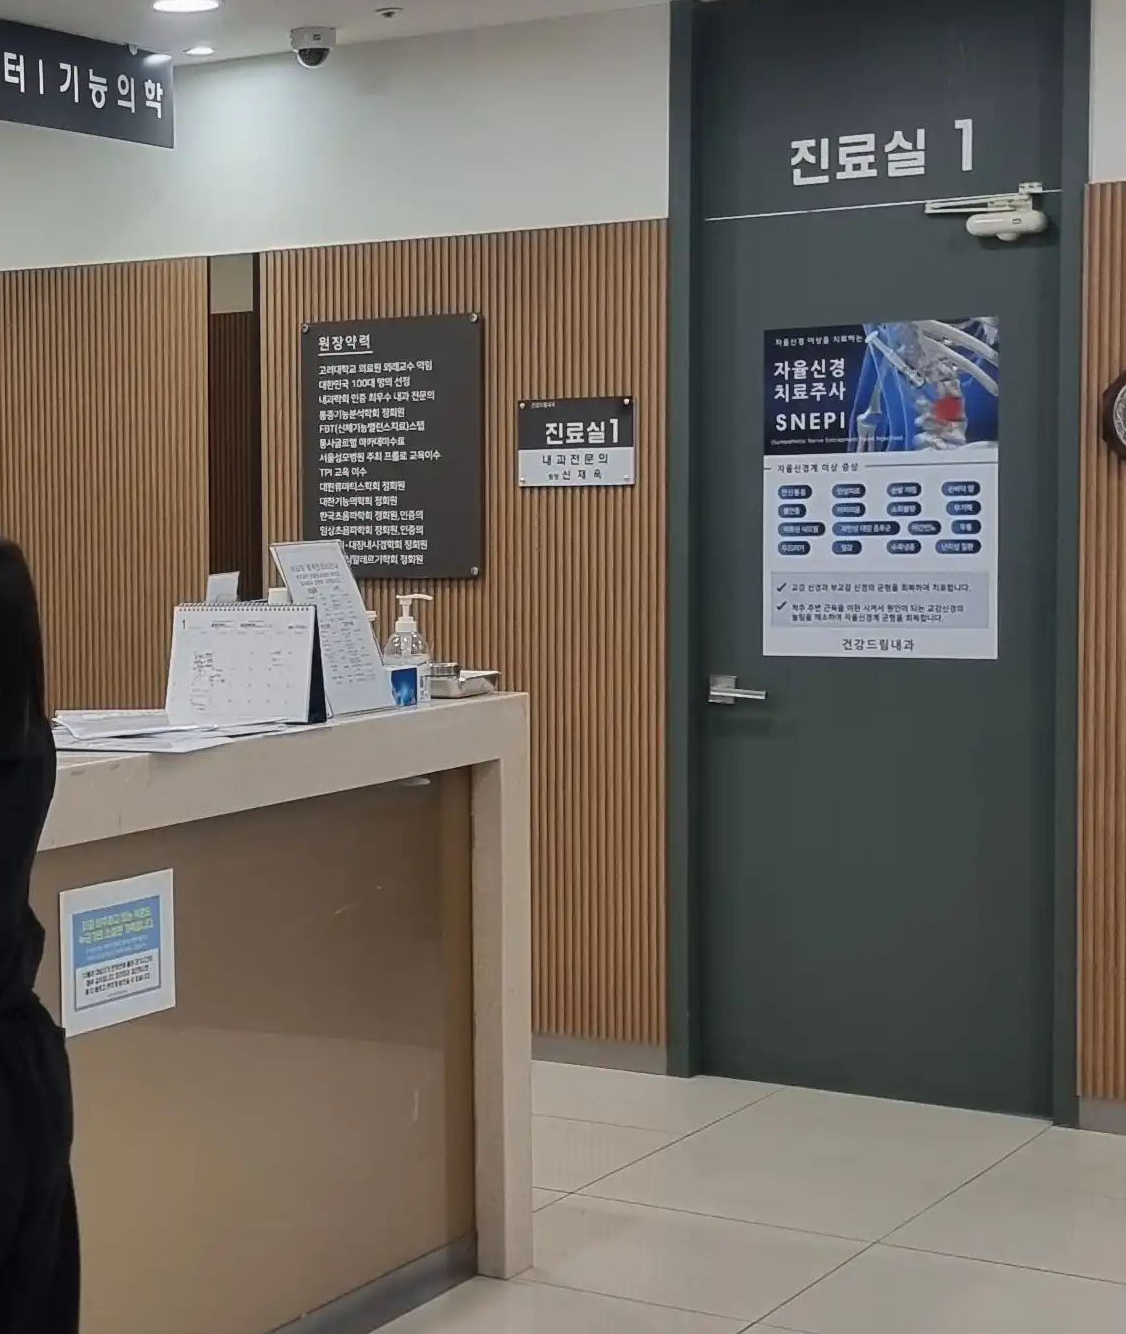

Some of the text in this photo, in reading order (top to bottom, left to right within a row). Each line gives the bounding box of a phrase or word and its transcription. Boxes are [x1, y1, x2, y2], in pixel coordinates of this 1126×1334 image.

[59, 63, 164, 119] 기능의학
[790, 118, 973, 186] 진료실 1
[318, 334, 370, 351] 원장약력
[774, 358, 845, 380] 자율신경
[319, 379, 349, 390] 대한민국
[351, 378, 375, 388] 100대
[774, 381, 846, 402] 치료주사
[775, 411, 845, 431] SNEPI
[842, 639, 914, 651] 건강드림내과
